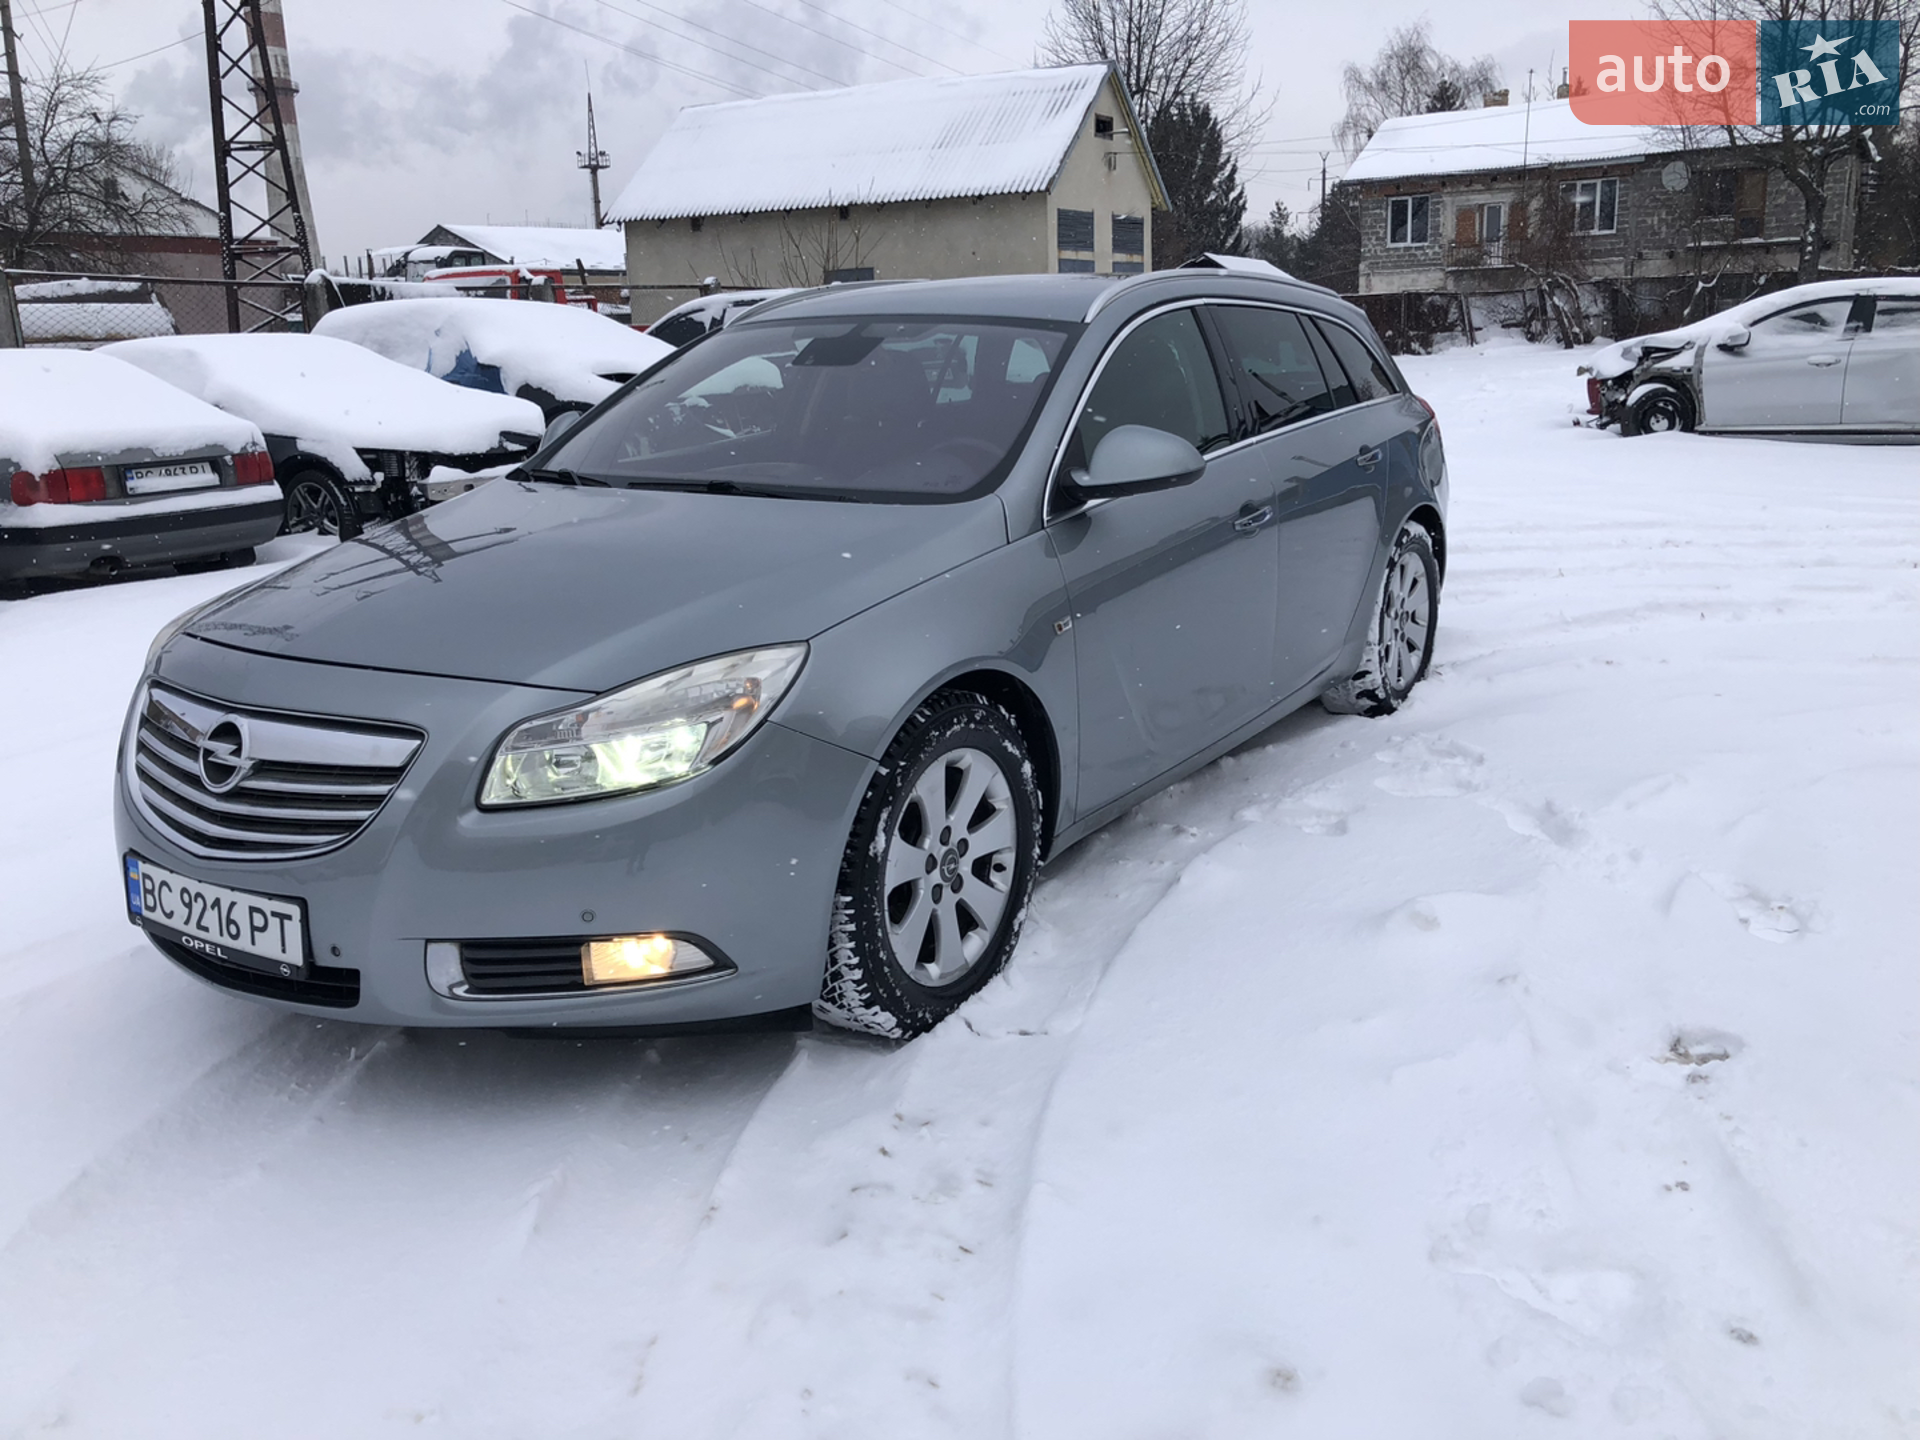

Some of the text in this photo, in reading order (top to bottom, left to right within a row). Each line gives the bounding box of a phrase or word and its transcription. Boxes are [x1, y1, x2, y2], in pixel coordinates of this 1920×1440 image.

[142, 872, 293, 954] BC 9216 PT
[182, 935, 228, 960] OPEL
